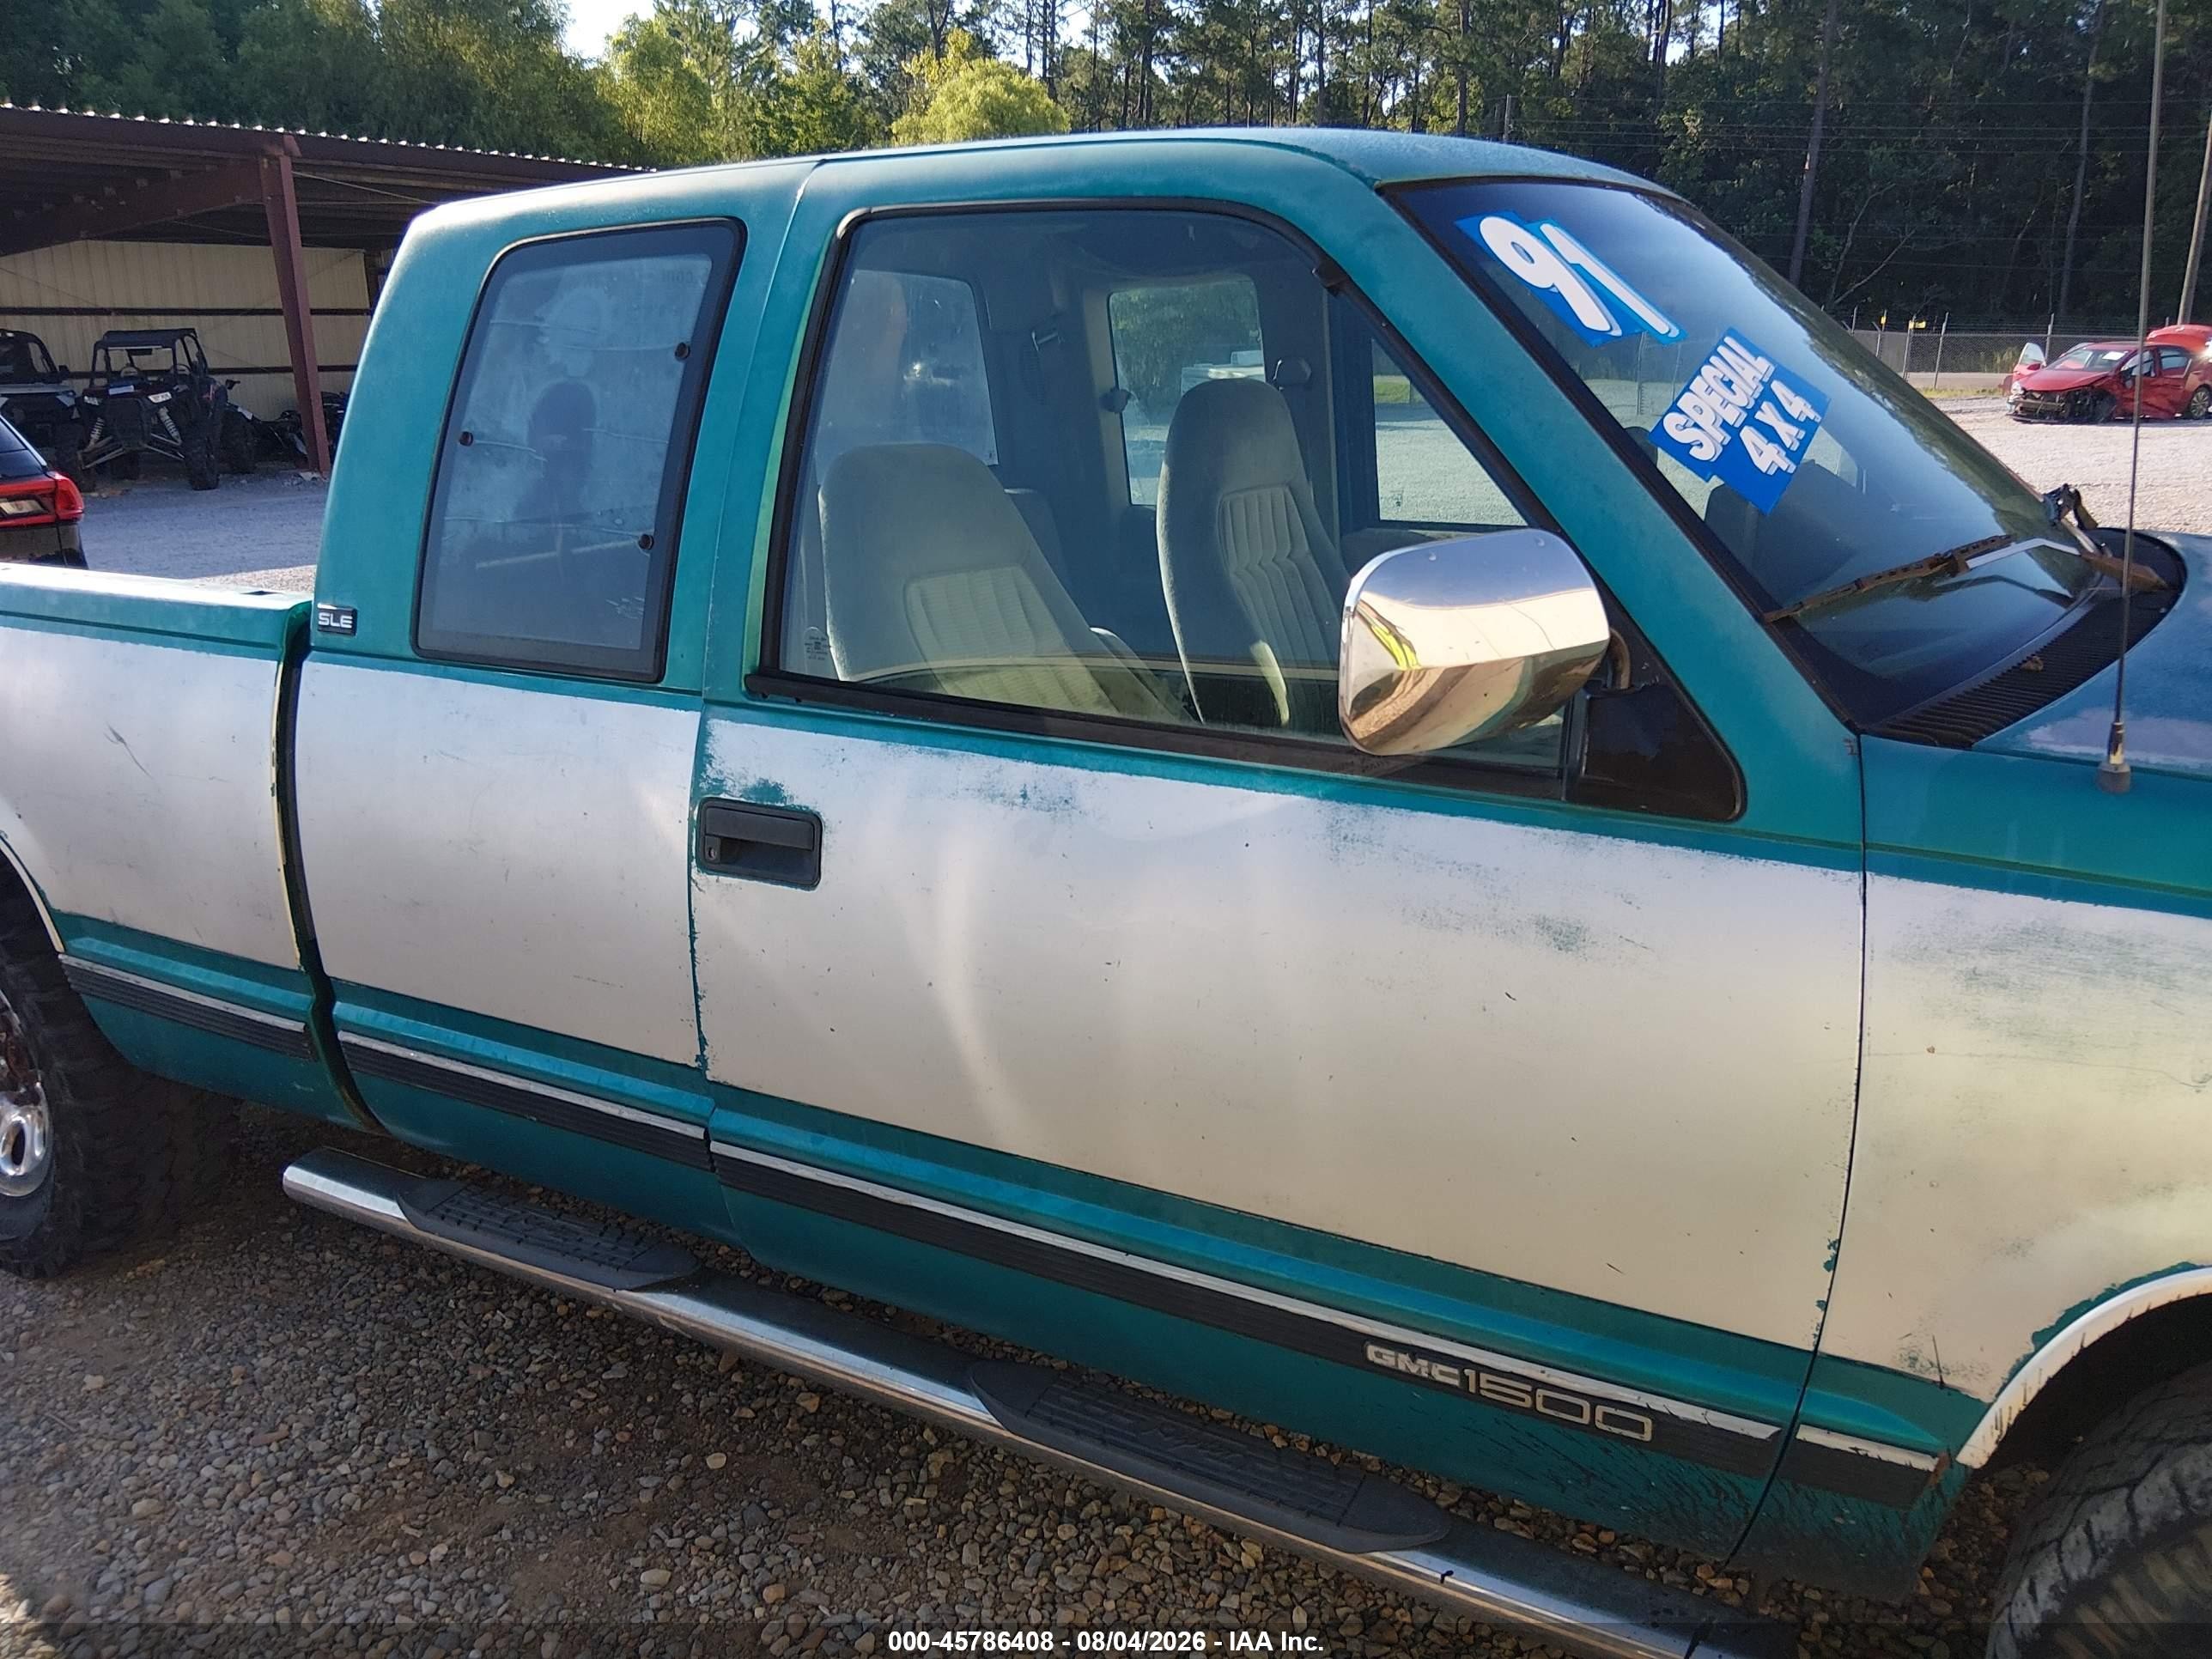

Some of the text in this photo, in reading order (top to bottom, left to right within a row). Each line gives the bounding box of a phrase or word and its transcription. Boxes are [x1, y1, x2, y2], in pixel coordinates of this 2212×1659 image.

[1480, 216, 1680, 337] 91
[1662, 336, 1775, 462] SPECIAL
[1739, 380, 1821, 476] 4X4
[318, 612, 354, 629] SLE
